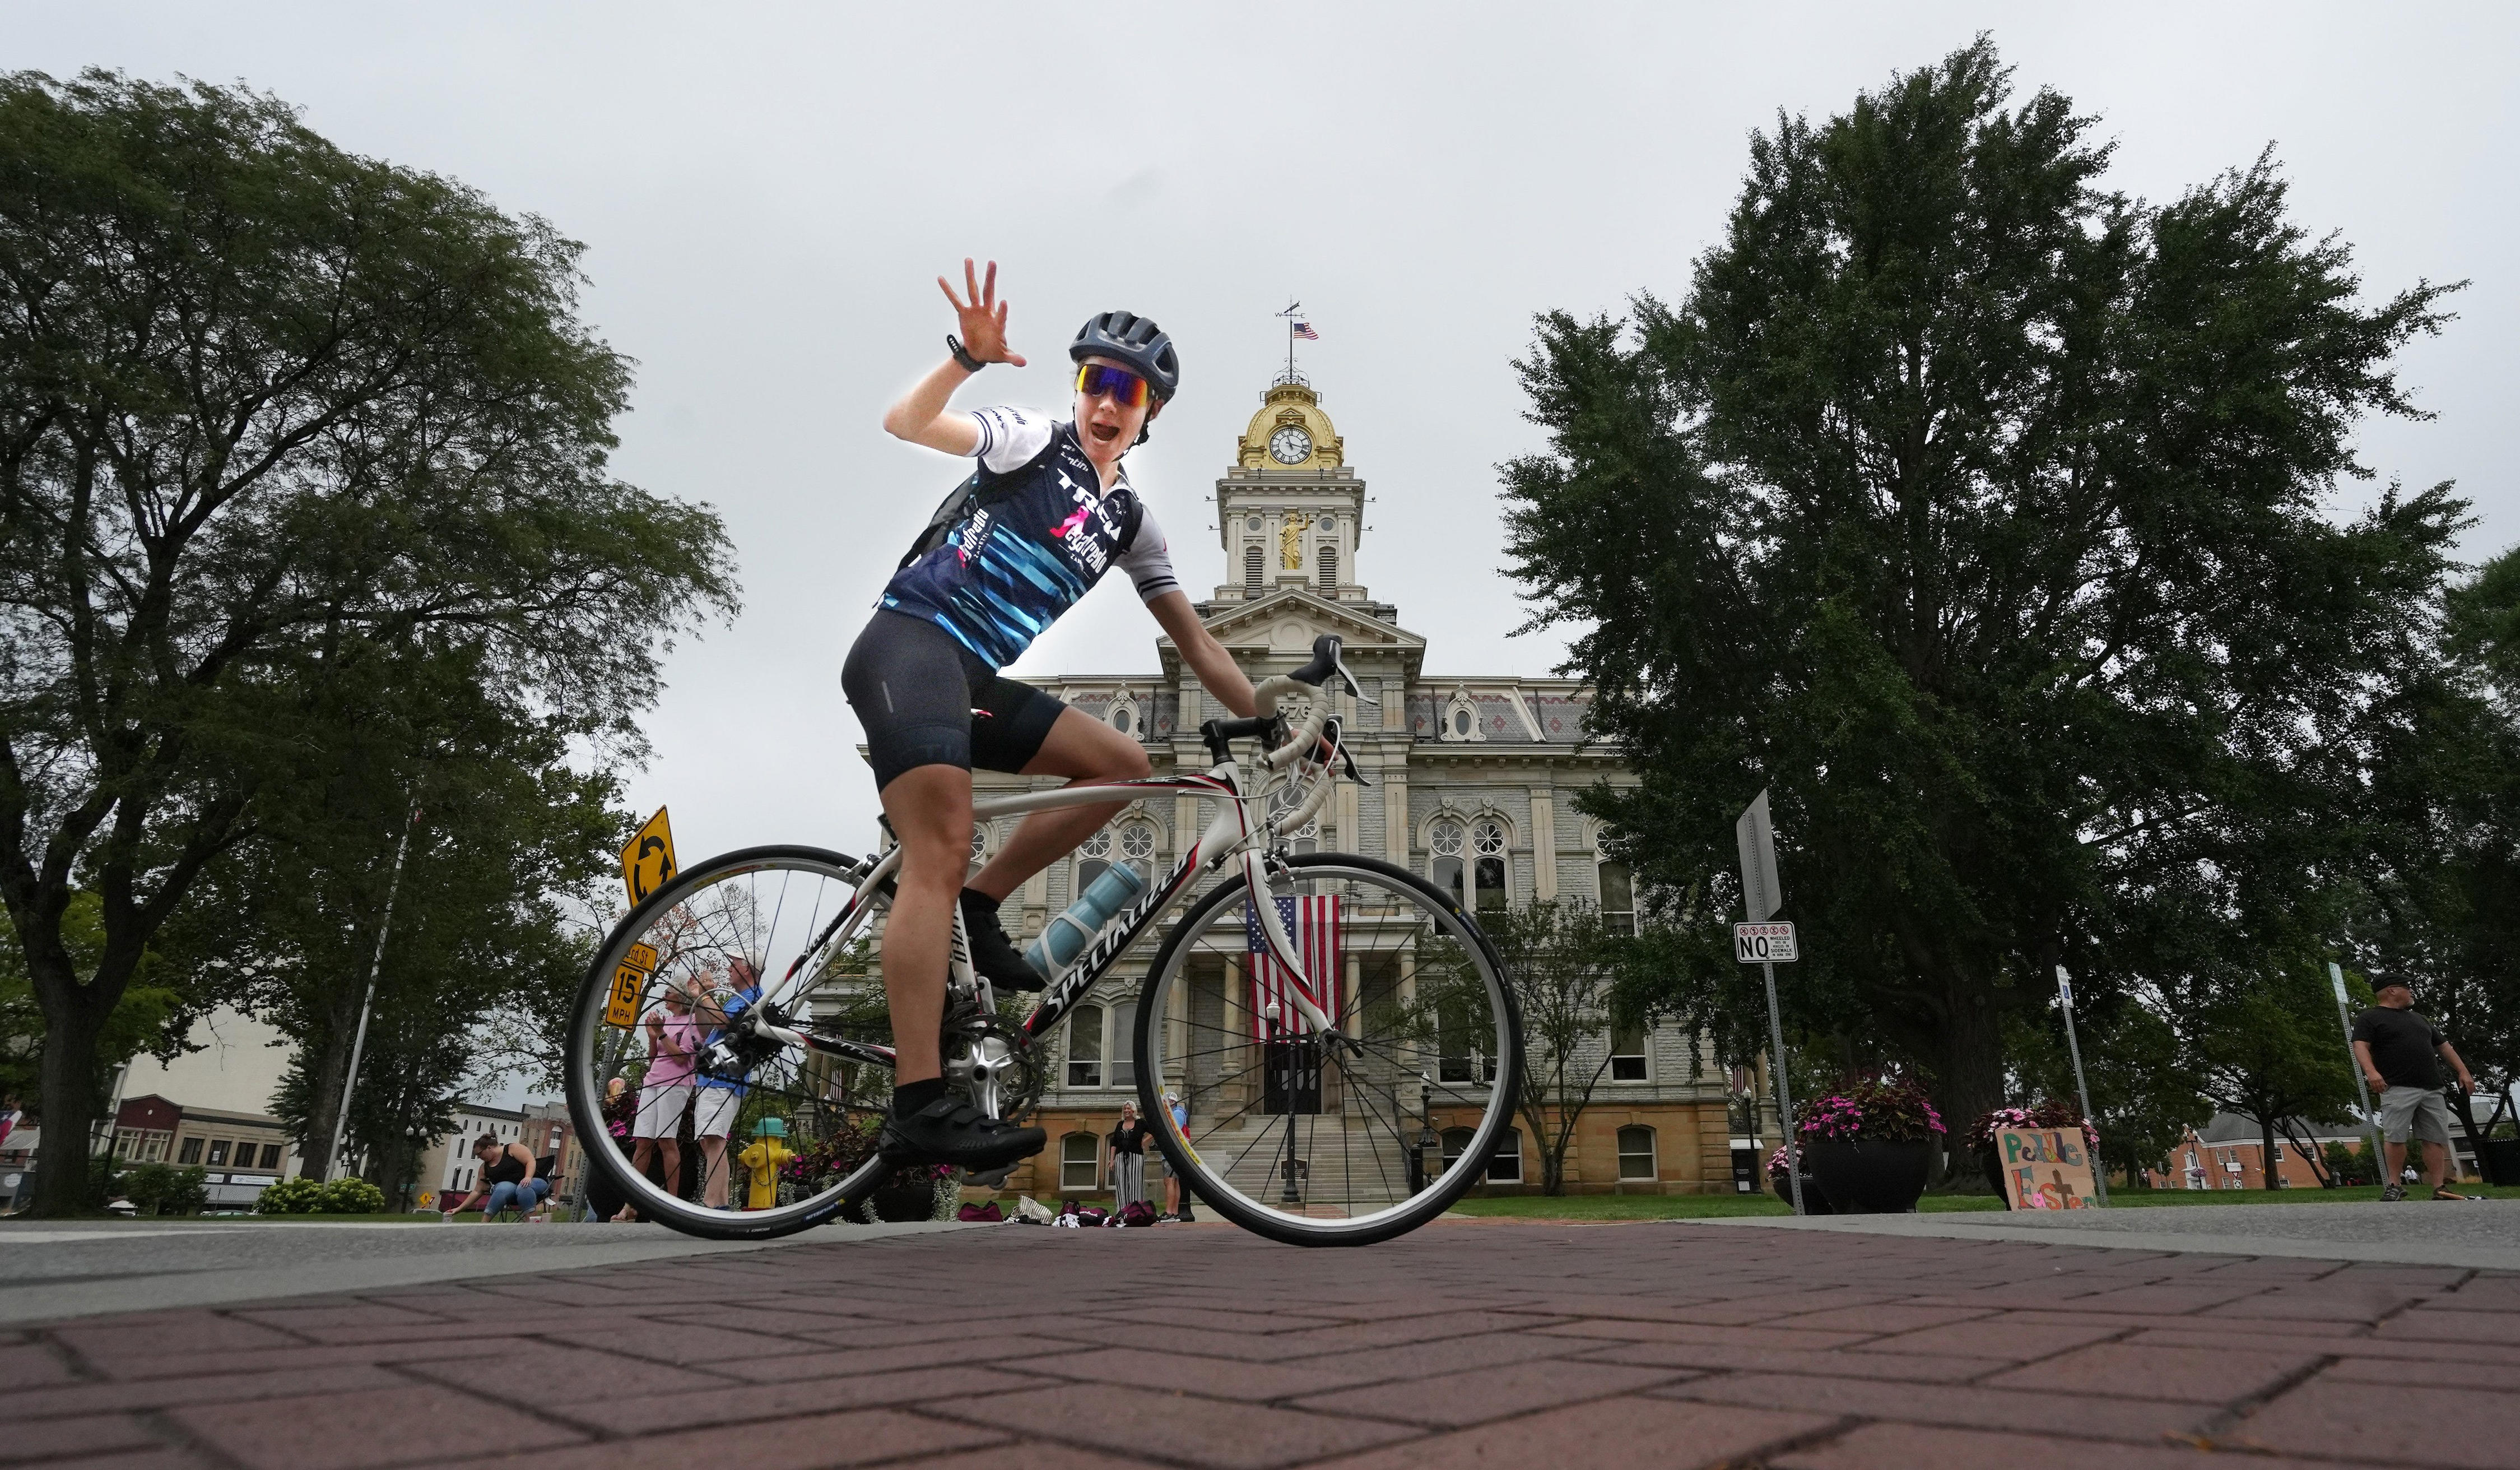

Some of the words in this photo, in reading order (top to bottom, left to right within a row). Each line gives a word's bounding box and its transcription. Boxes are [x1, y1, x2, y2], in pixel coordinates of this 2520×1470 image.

[1278, 704, 1312, 719] 876
[1047, 854, 1188, 1022] SPECIALIZED
[1740, 936, 1769, 958] NO
[631, 948, 640, 962] rd
[640, 949, 649, 966] St
[617, 972, 637, 1004] 15
[612, 1007, 630, 1023] MPH
[2003, 1132, 2083, 1167] Peddle
